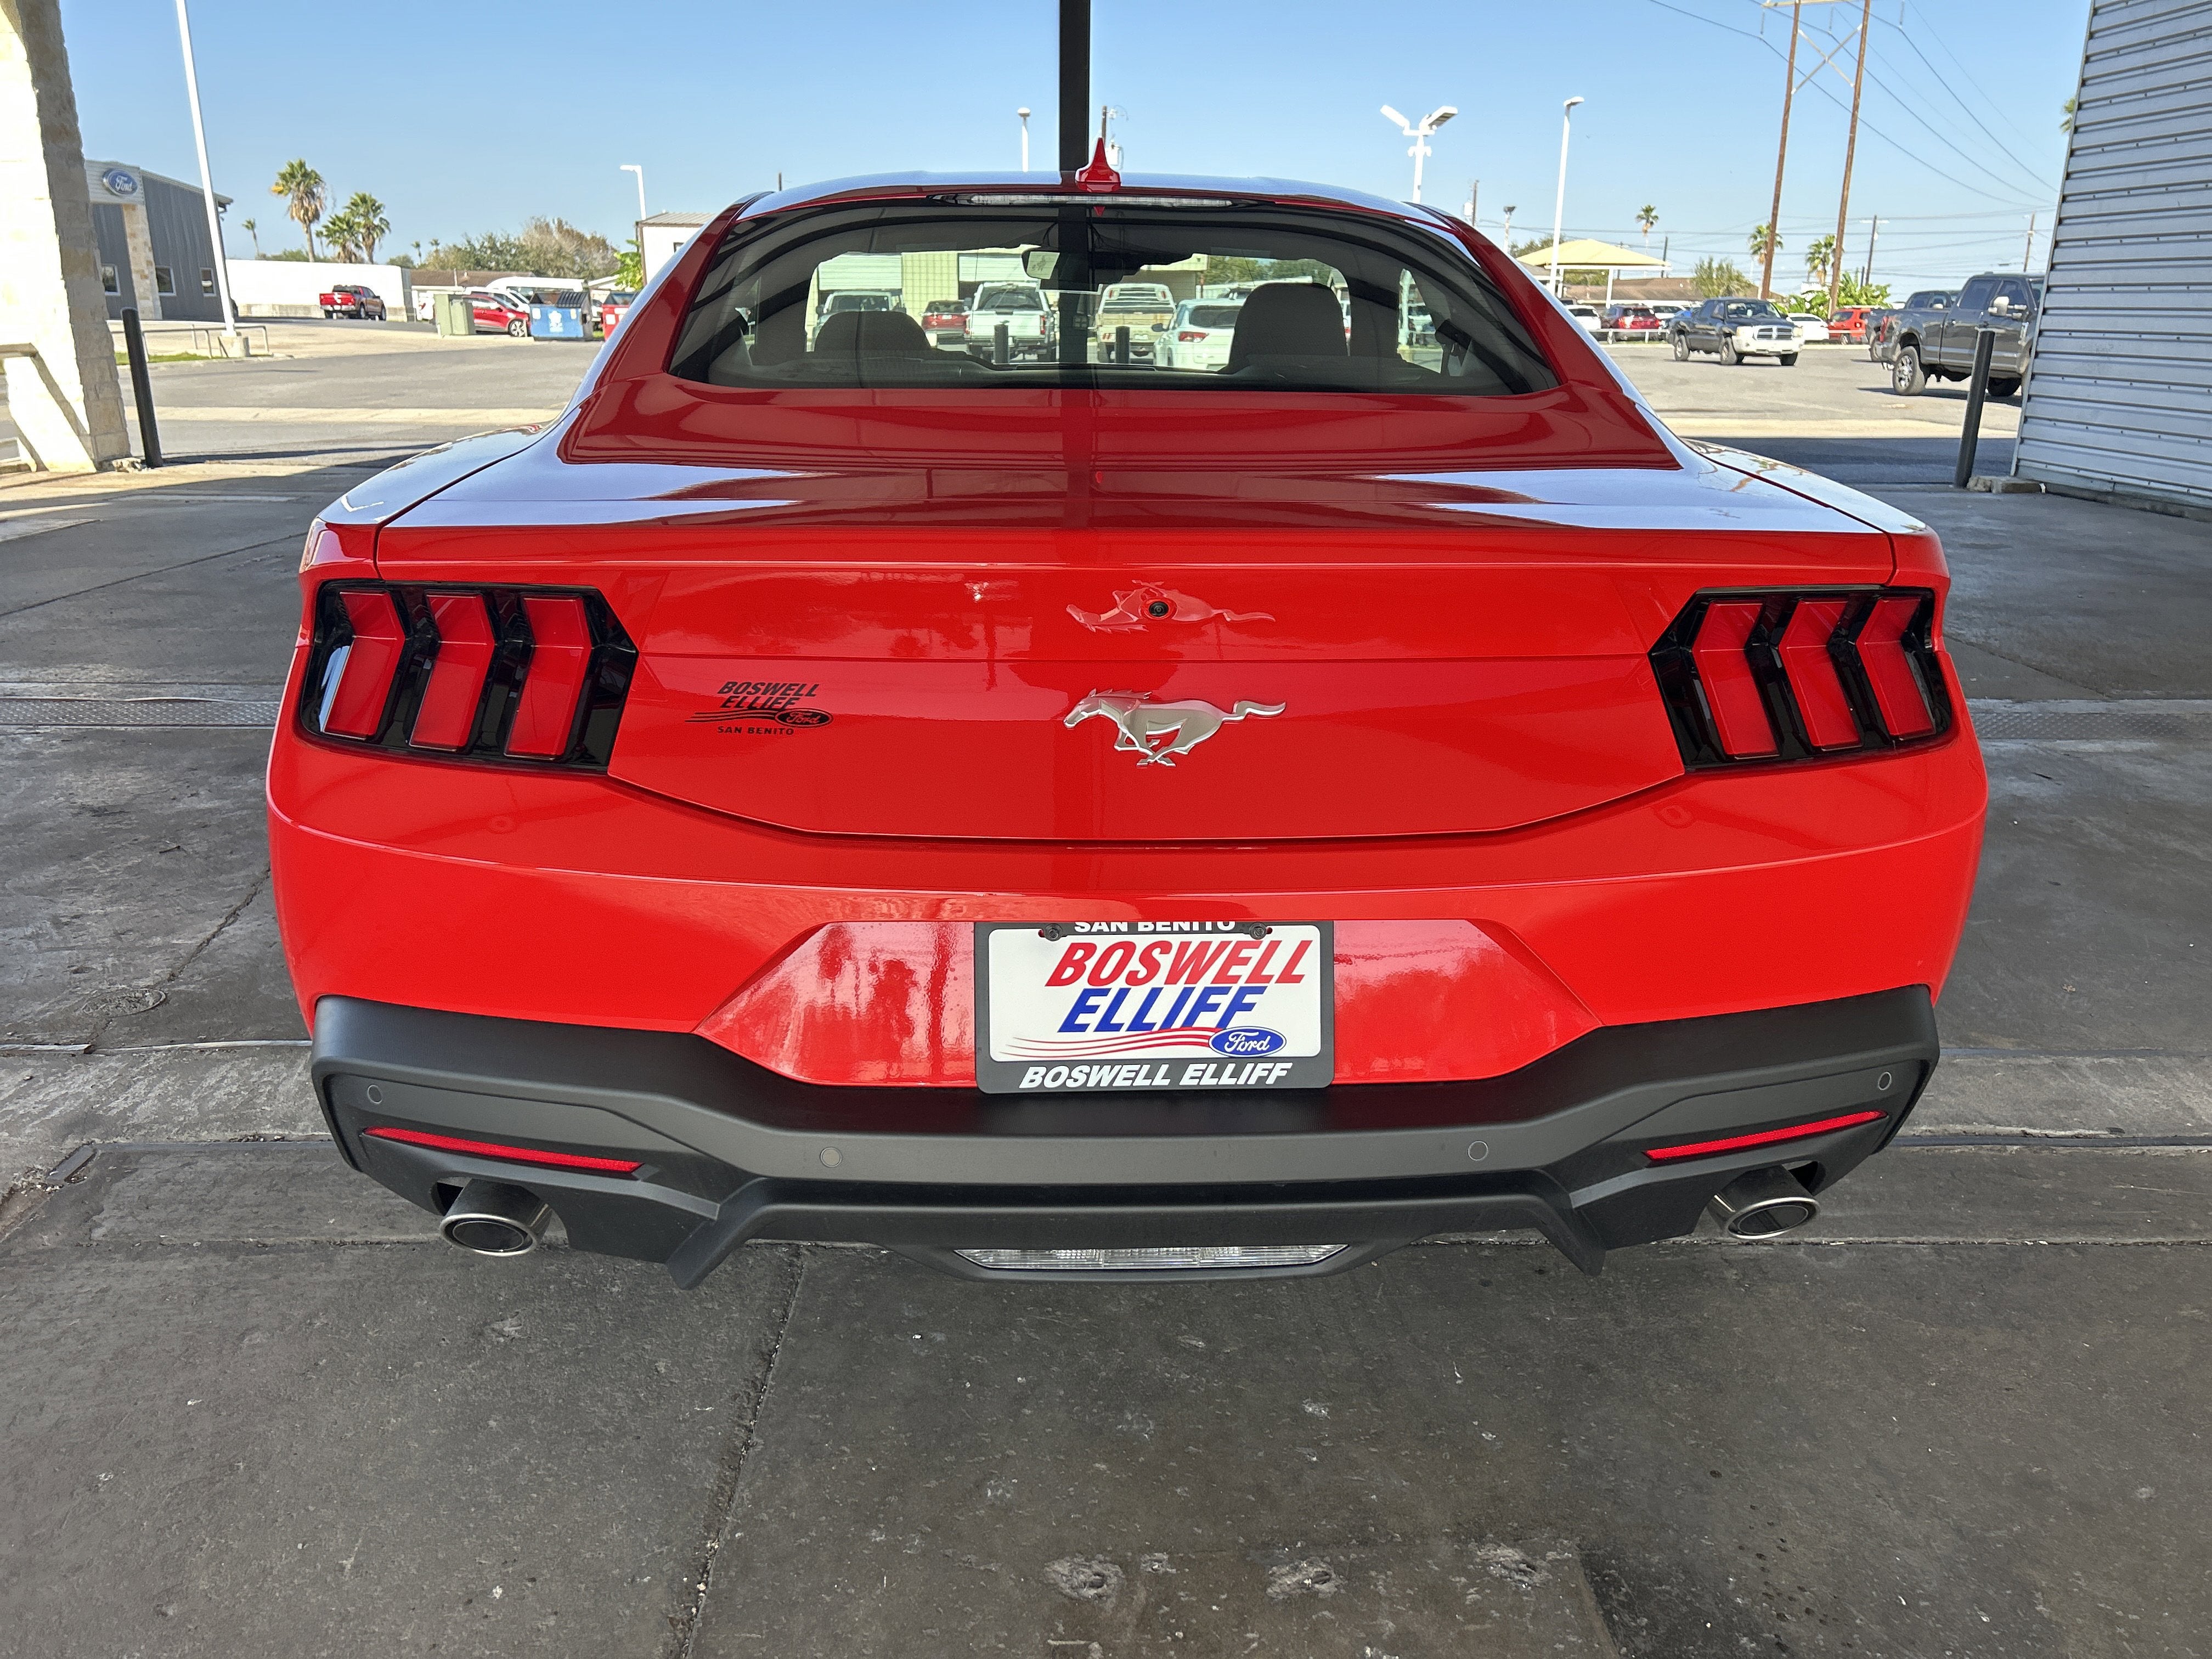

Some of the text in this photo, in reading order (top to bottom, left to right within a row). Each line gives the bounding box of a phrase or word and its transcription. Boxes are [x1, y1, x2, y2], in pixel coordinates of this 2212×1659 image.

[115, 175, 133, 191] Ford
[717, 681, 820, 697] BOSWELL
[719, 695, 801, 710] ELLIFF
[785, 712, 821, 724] Ford
[717, 725, 795, 735] SAN BENITO
[1074, 921, 1235, 933] SAN BENITO
[1045, 940, 1313, 987] BOSWELL
[1057, 986, 1268, 1032] ELLIFF
[1223, 1031, 1271, 1052] Ford
[1019, 1062, 1293, 1089] BOSWELL ELLIFF
